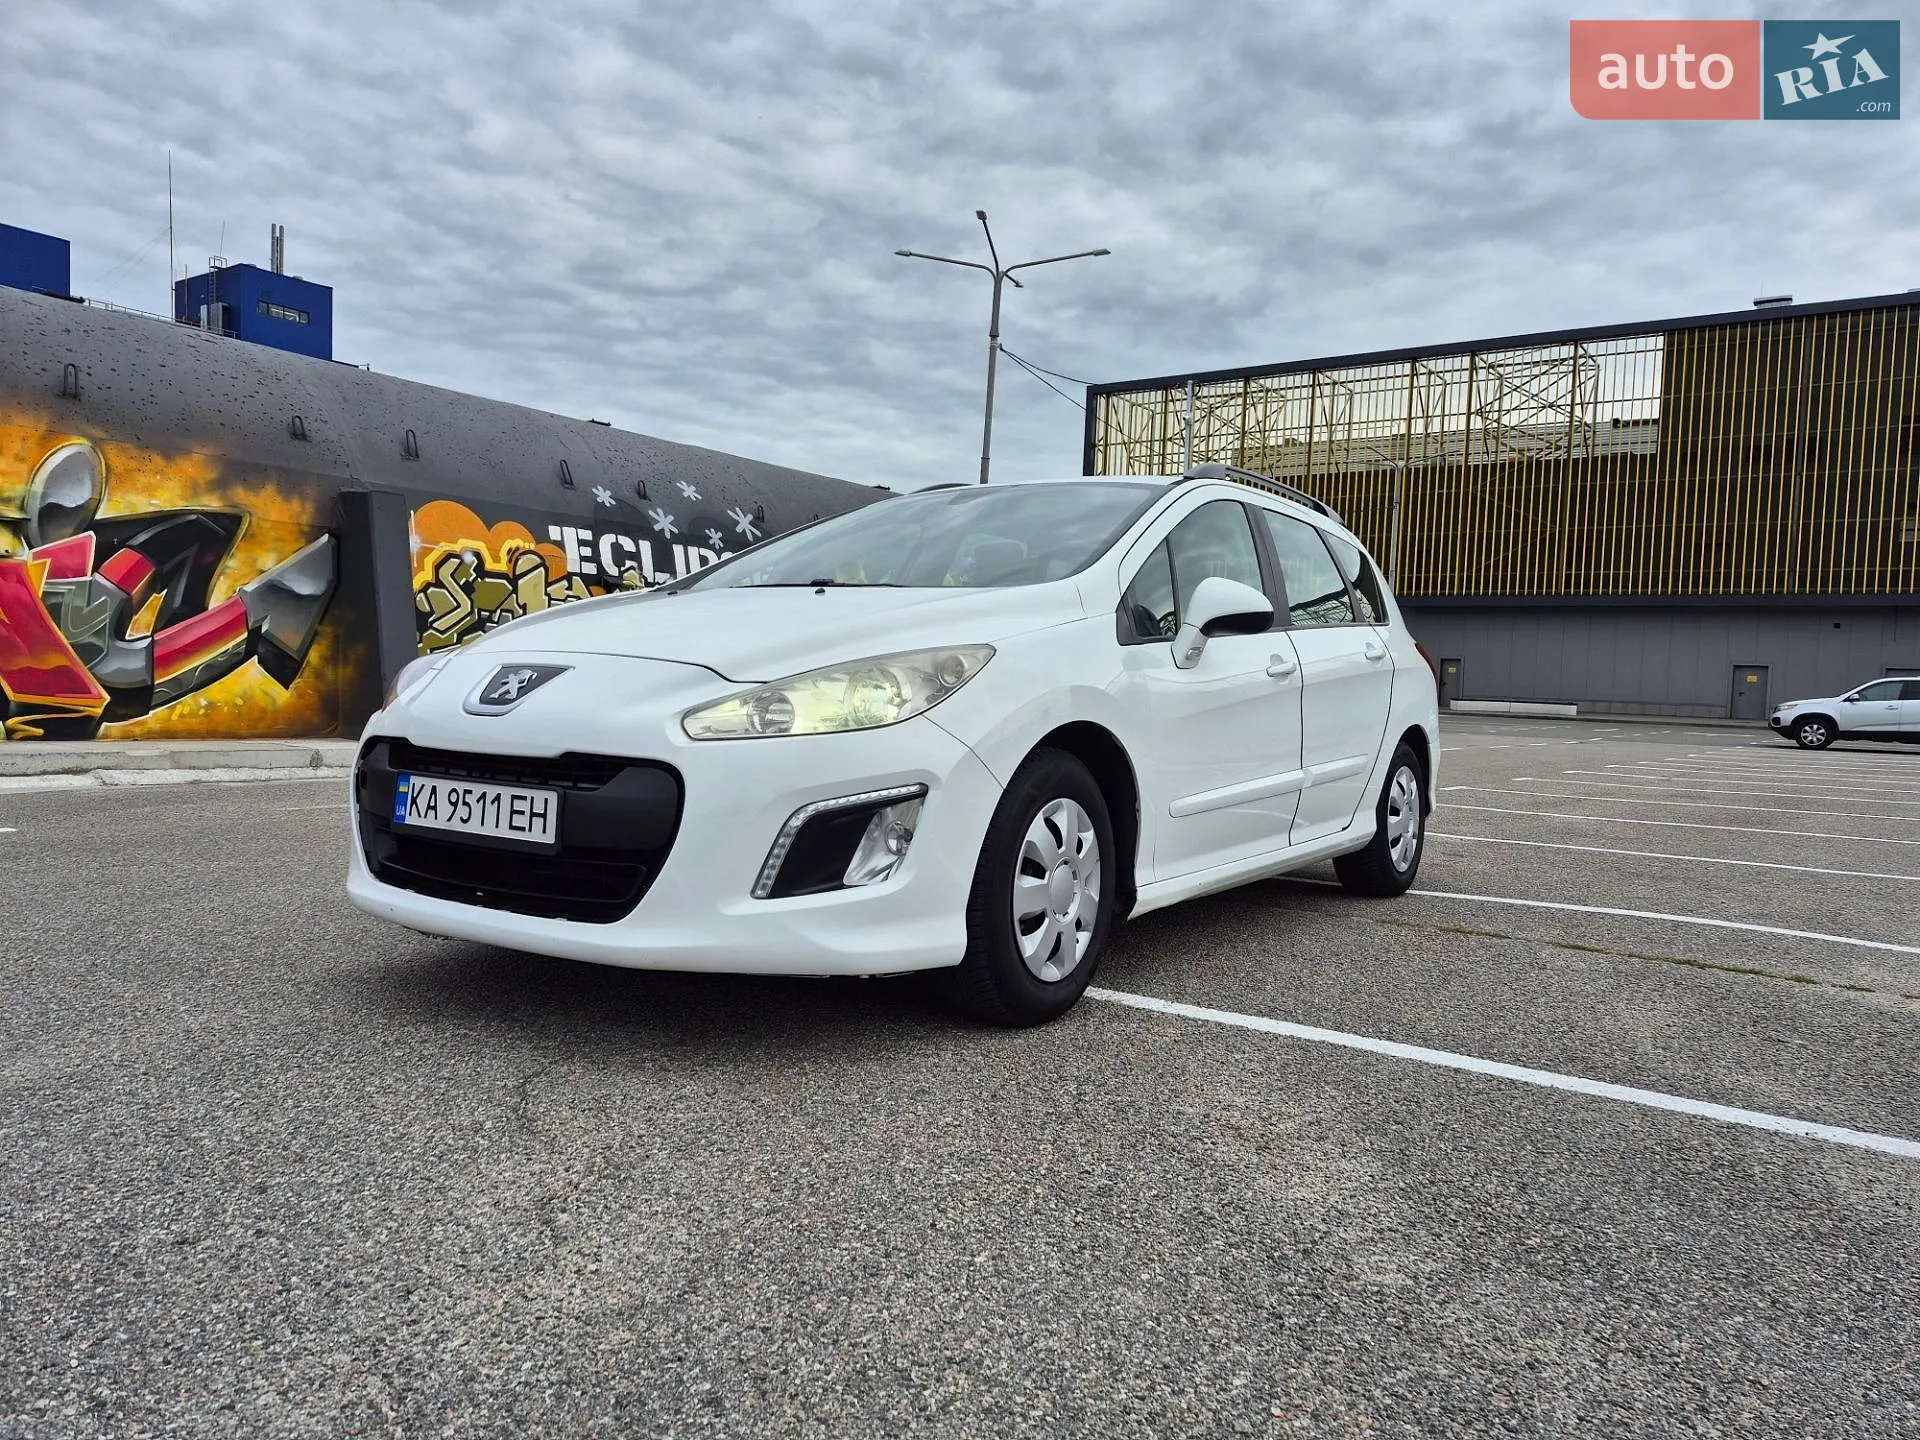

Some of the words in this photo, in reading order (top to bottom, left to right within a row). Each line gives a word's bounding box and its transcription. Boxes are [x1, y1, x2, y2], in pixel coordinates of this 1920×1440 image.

[548, 525, 736, 583] ECLIP
[408, 782, 438, 820] KA
[446, 787, 502, 829] 9511
[508, 794, 549, 834] EH
